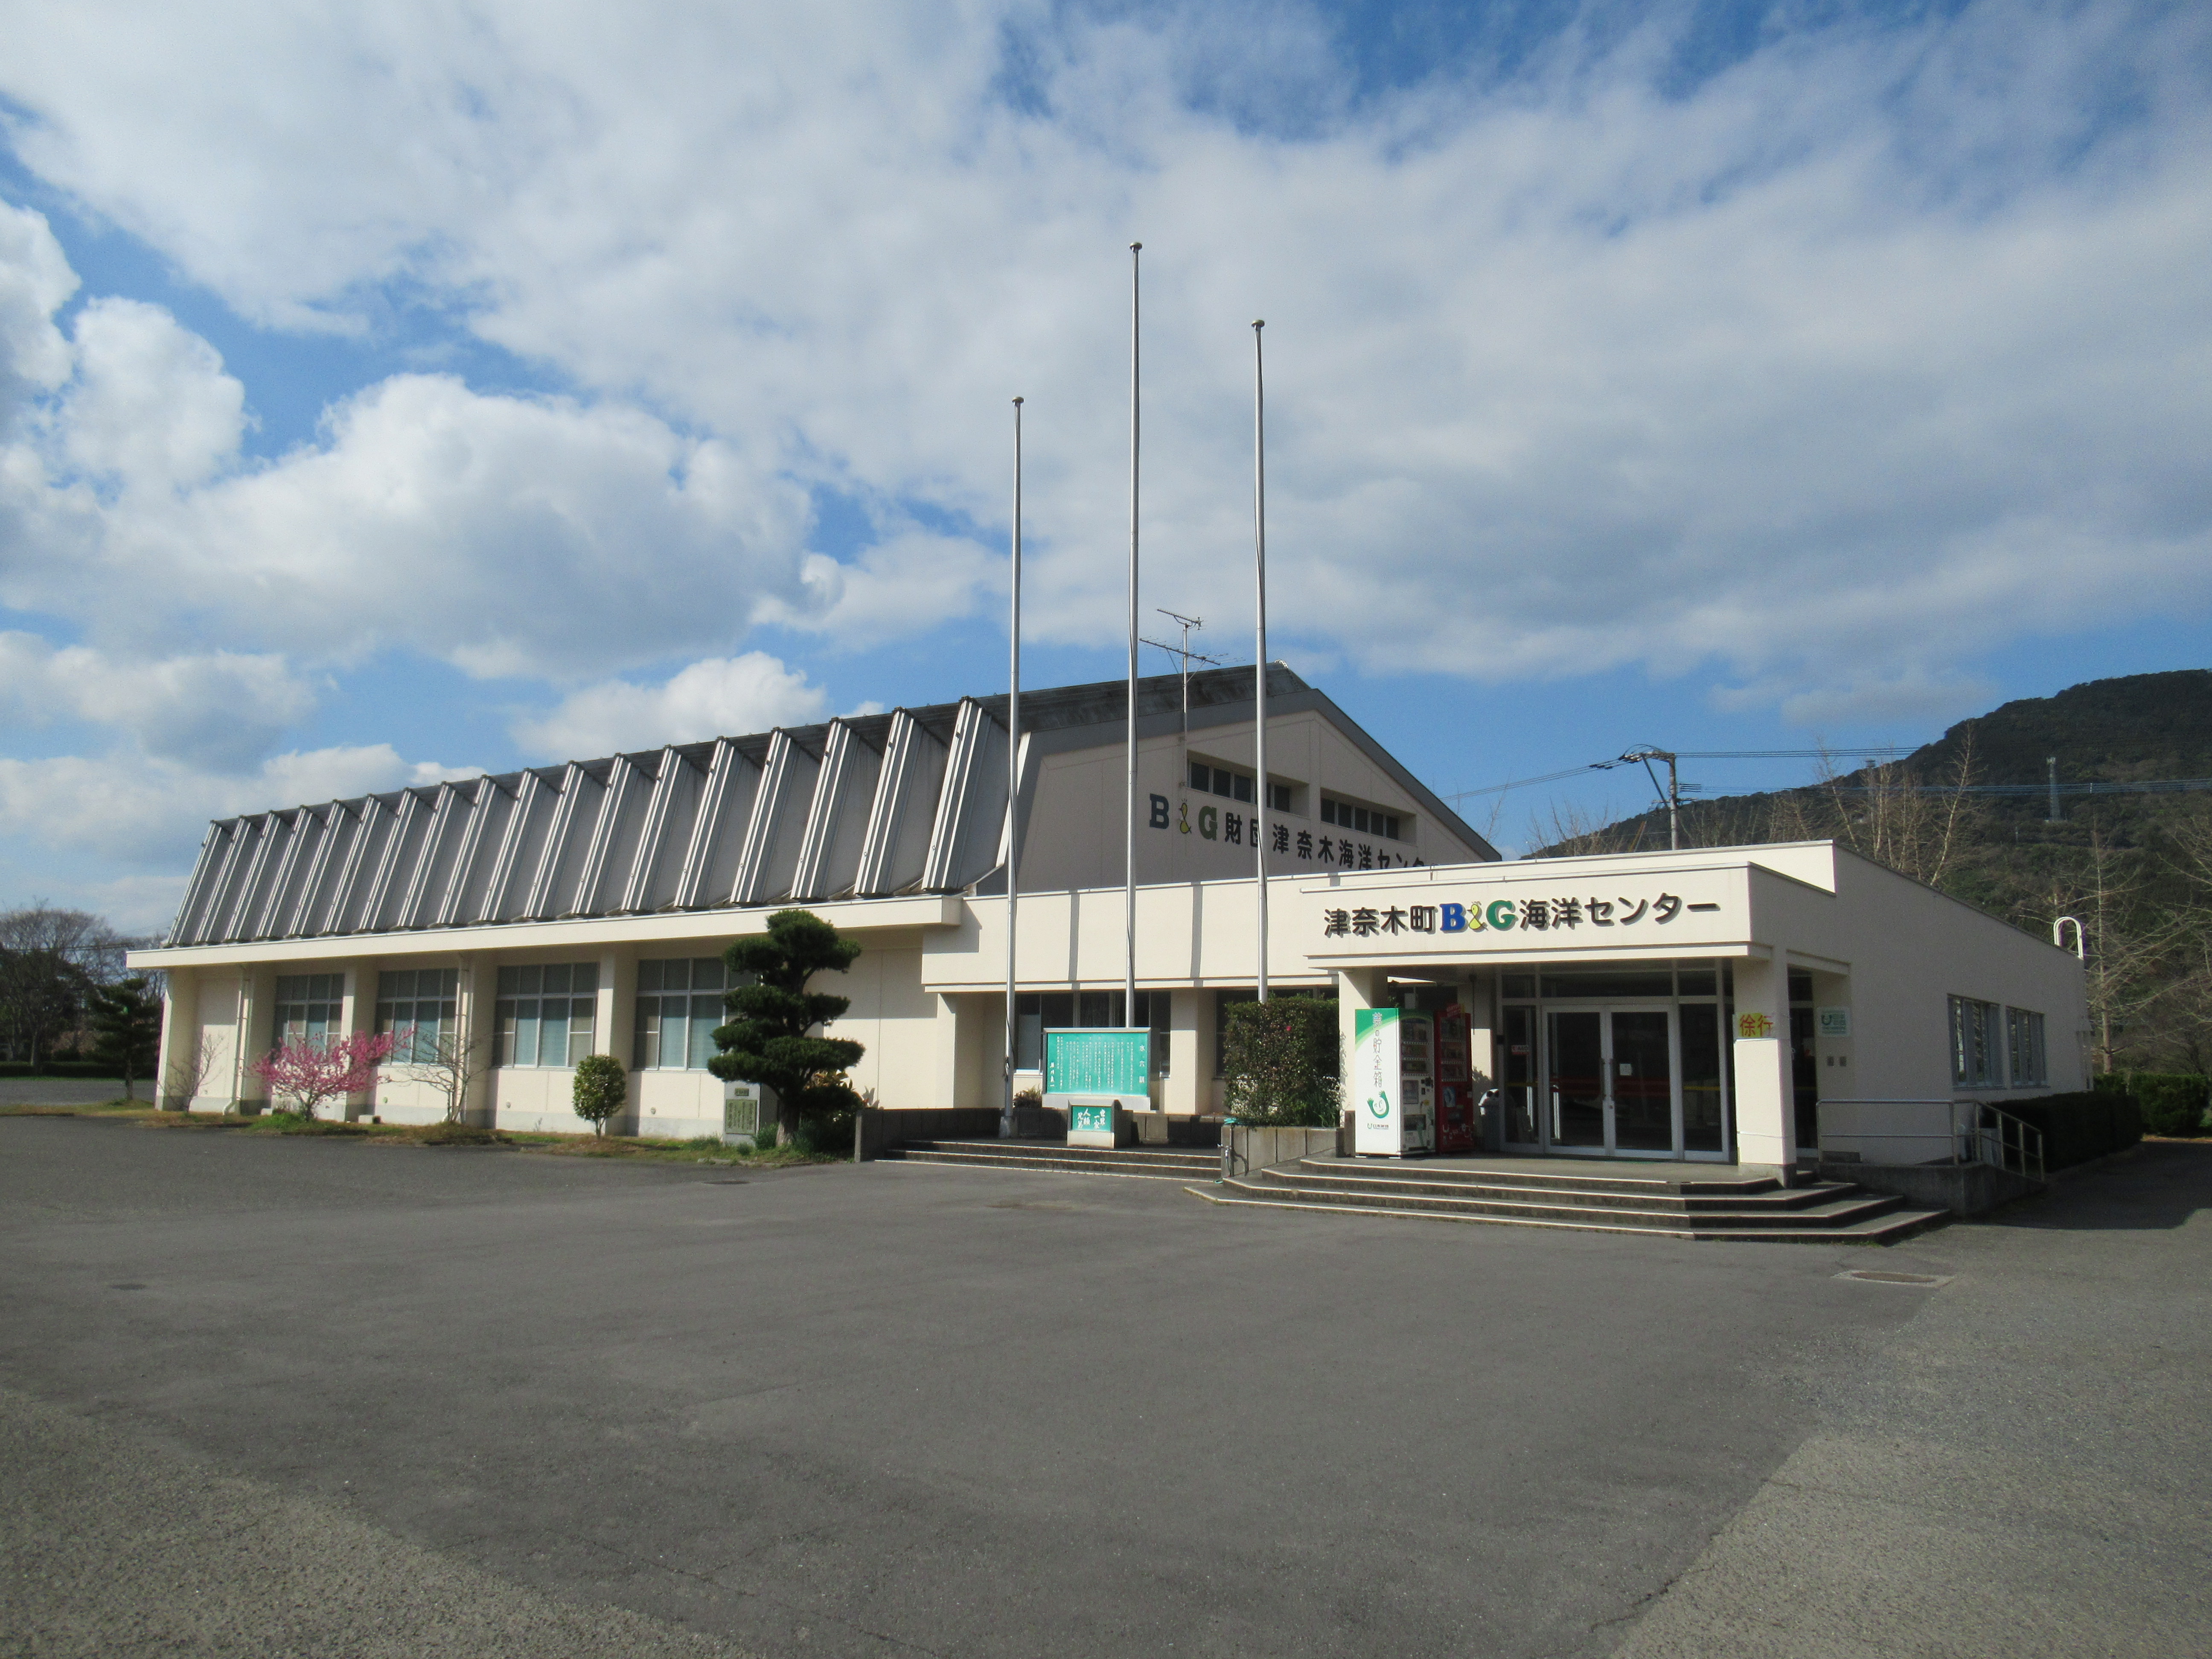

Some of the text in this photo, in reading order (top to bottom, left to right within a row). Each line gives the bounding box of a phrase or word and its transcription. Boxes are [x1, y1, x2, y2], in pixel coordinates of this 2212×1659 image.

[1324, 893, 1720, 937] 津奈木町B&G海洋センター
[1740, 1014, 1774, 1037] 徐行
[1372, 1012, 1382, 1088] 夢の貯金箱
